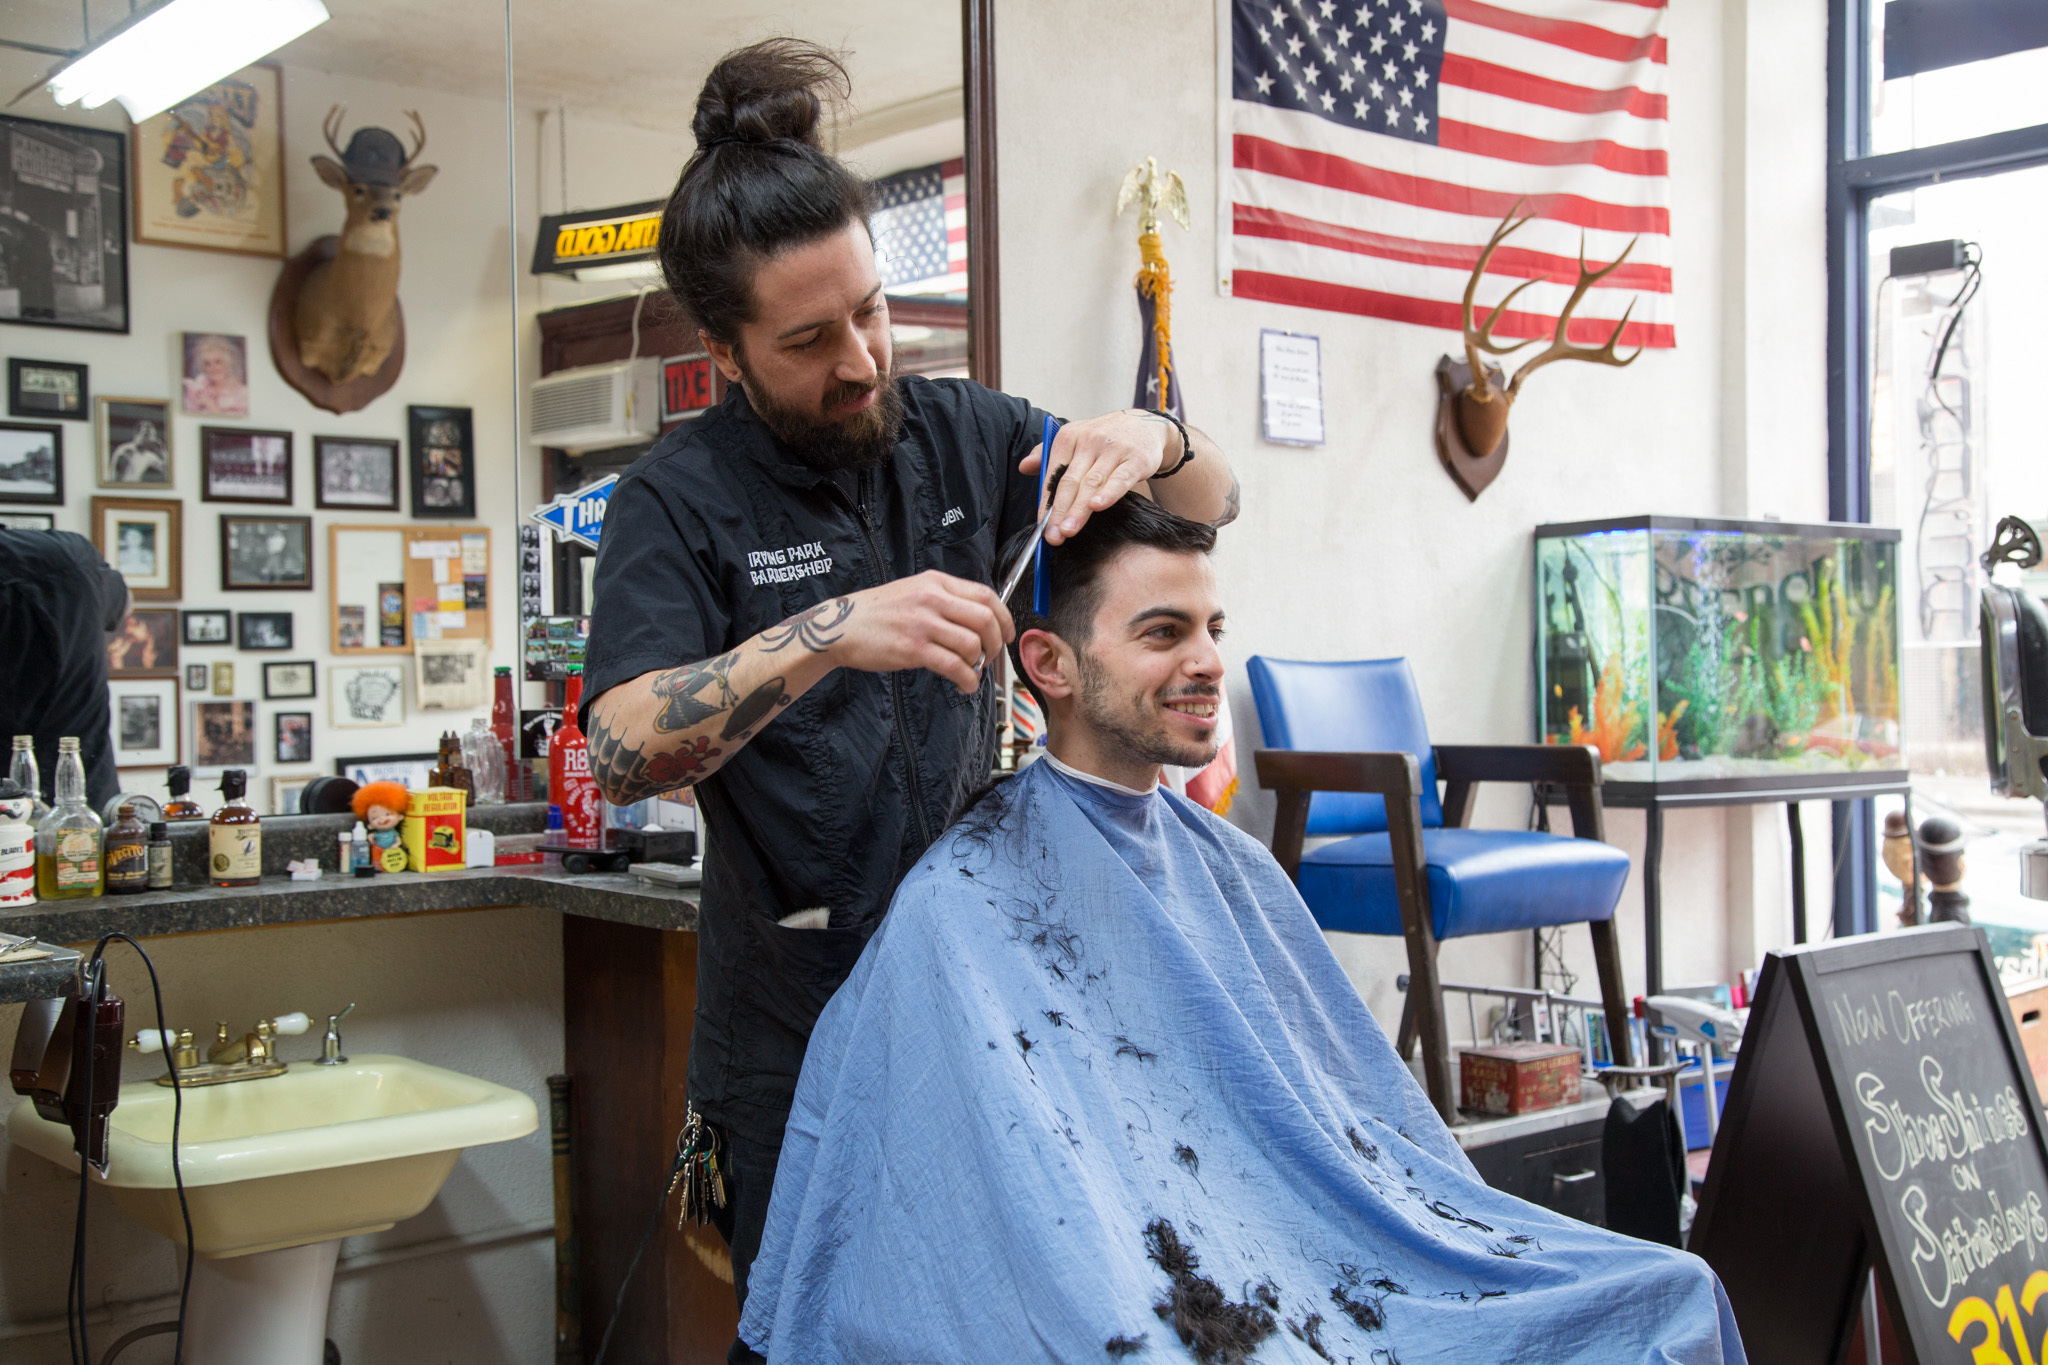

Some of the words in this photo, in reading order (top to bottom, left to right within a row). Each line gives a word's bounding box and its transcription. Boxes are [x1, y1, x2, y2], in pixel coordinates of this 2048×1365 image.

[559, 497, 607, 537] THR
[941, 506, 965, 526] JON
[787, 540, 827, 562] PARK
[749, 557, 833, 586] BARBERSHOP
[423, 802, 458, 812] REGULATOR
[427, 792, 454, 802] VOLTAGE
